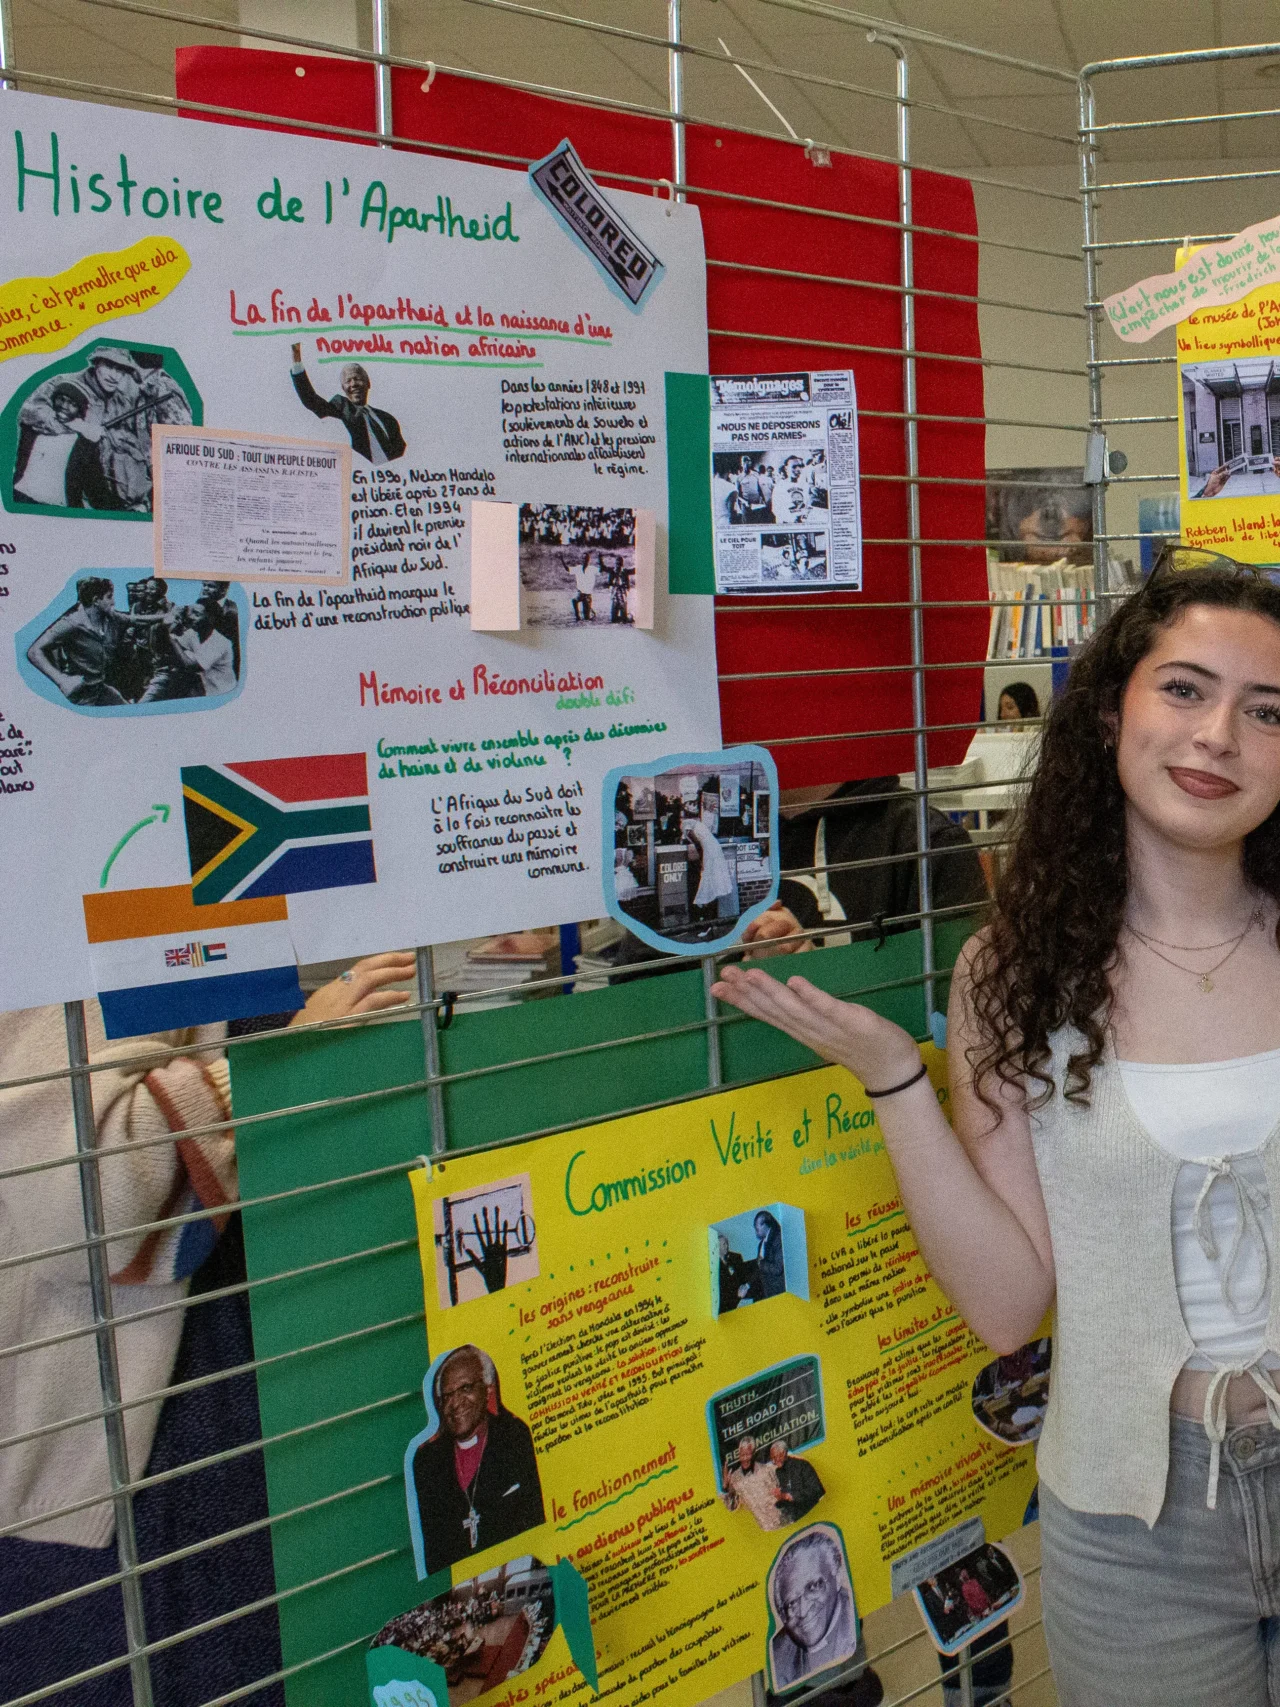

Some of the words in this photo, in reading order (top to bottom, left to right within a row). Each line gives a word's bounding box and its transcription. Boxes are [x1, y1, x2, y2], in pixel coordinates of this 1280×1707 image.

[14, 129, 225, 224] Histoire
[256, 176, 305, 223] de
[325, 177, 520, 243] l'Apartheid
[548, 157, 648, 281] COLORED
[96, 285, 160, 314] anonyme
[230, 289, 266, 326] La
[271, 288, 301, 323] fin
[307, 298, 332, 322] de
[338, 293, 449, 327] l'apartheid
[455, 305, 473, 326] et
[477, 306, 495, 326] la
[500, 310, 570, 334] naissance
[574, 313, 613, 338] d'une
[316, 333, 394, 354] nouvelle
[400, 335, 459, 357] nation
[501, 379, 529, 394] Dans
[548, 380, 583, 394] années
[586, 379, 609, 394] 1848
[610, 381, 620, 394] et
[623, 380, 646, 394] 1991
[715, 377, 804, 396] Témoignages
[732, 433, 749, 441] PAS
[751, 432, 769, 441] NOS
[748, 423, 760, 431] NE
[762, 420, 820, 430] DÉPOSERONS
[166, 443, 200, 456] AFRIQUE
[203, 446, 215, 457] DU
[218, 447, 234, 460] SUD
[242, 451, 262, 464] TOUT
[265, 452, 275, 464] UN
[277, 455, 305, 466] PEUPLE
[307, 457, 337, 469] DEBOUT
[353, 470, 367, 484] En
[372, 470, 406, 486] 1990,
[410, 468, 447, 483] Nelson
[450, 468, 495, 481] Mandela
[594, 464, 603, 474] le
[607, 464, 649, 478] régime.
[352, 563, 397, 581] Afrique
[401, 561, 418, 573] du
[419, 555, 448, 570] Sud.
[359, 670, 443, 707] Mémoire
[449, 679, 466, 701] et
[473, 664, 604, 696] Réconciliation
[555, 691, 601, 711] double
[605, 686, 635, 707] défi
[431, 794, 500, 814] L'Afrique
[503, 791, 522, 806] du
[525, 787, 553, 802] Sud
[557, 781, 584, 798] doit
[661, 861, 688, 873] COLORED
[664, 873, 683, 883] ONLY
[565, 1150, 696, 1217] Commission
[710, 1111, 773, 1167] Vérité
[793, 1108, 812, 1148] et
[519, 1308, 535, 1327] les
[540, 1286, 586, 1318] origines
[594, 1257, 660, 1291] reconstruire
[720, 1390, 758, 1414] TRUTH.
[722, 1421, 744, 1438] THE
[747, 1404, 777, 1427] ROAD
[779, 1395, 794, 1408] TO
[552, 1499, 567, 1522] le
[572, 1442, 676, 1509] fonctionnement
